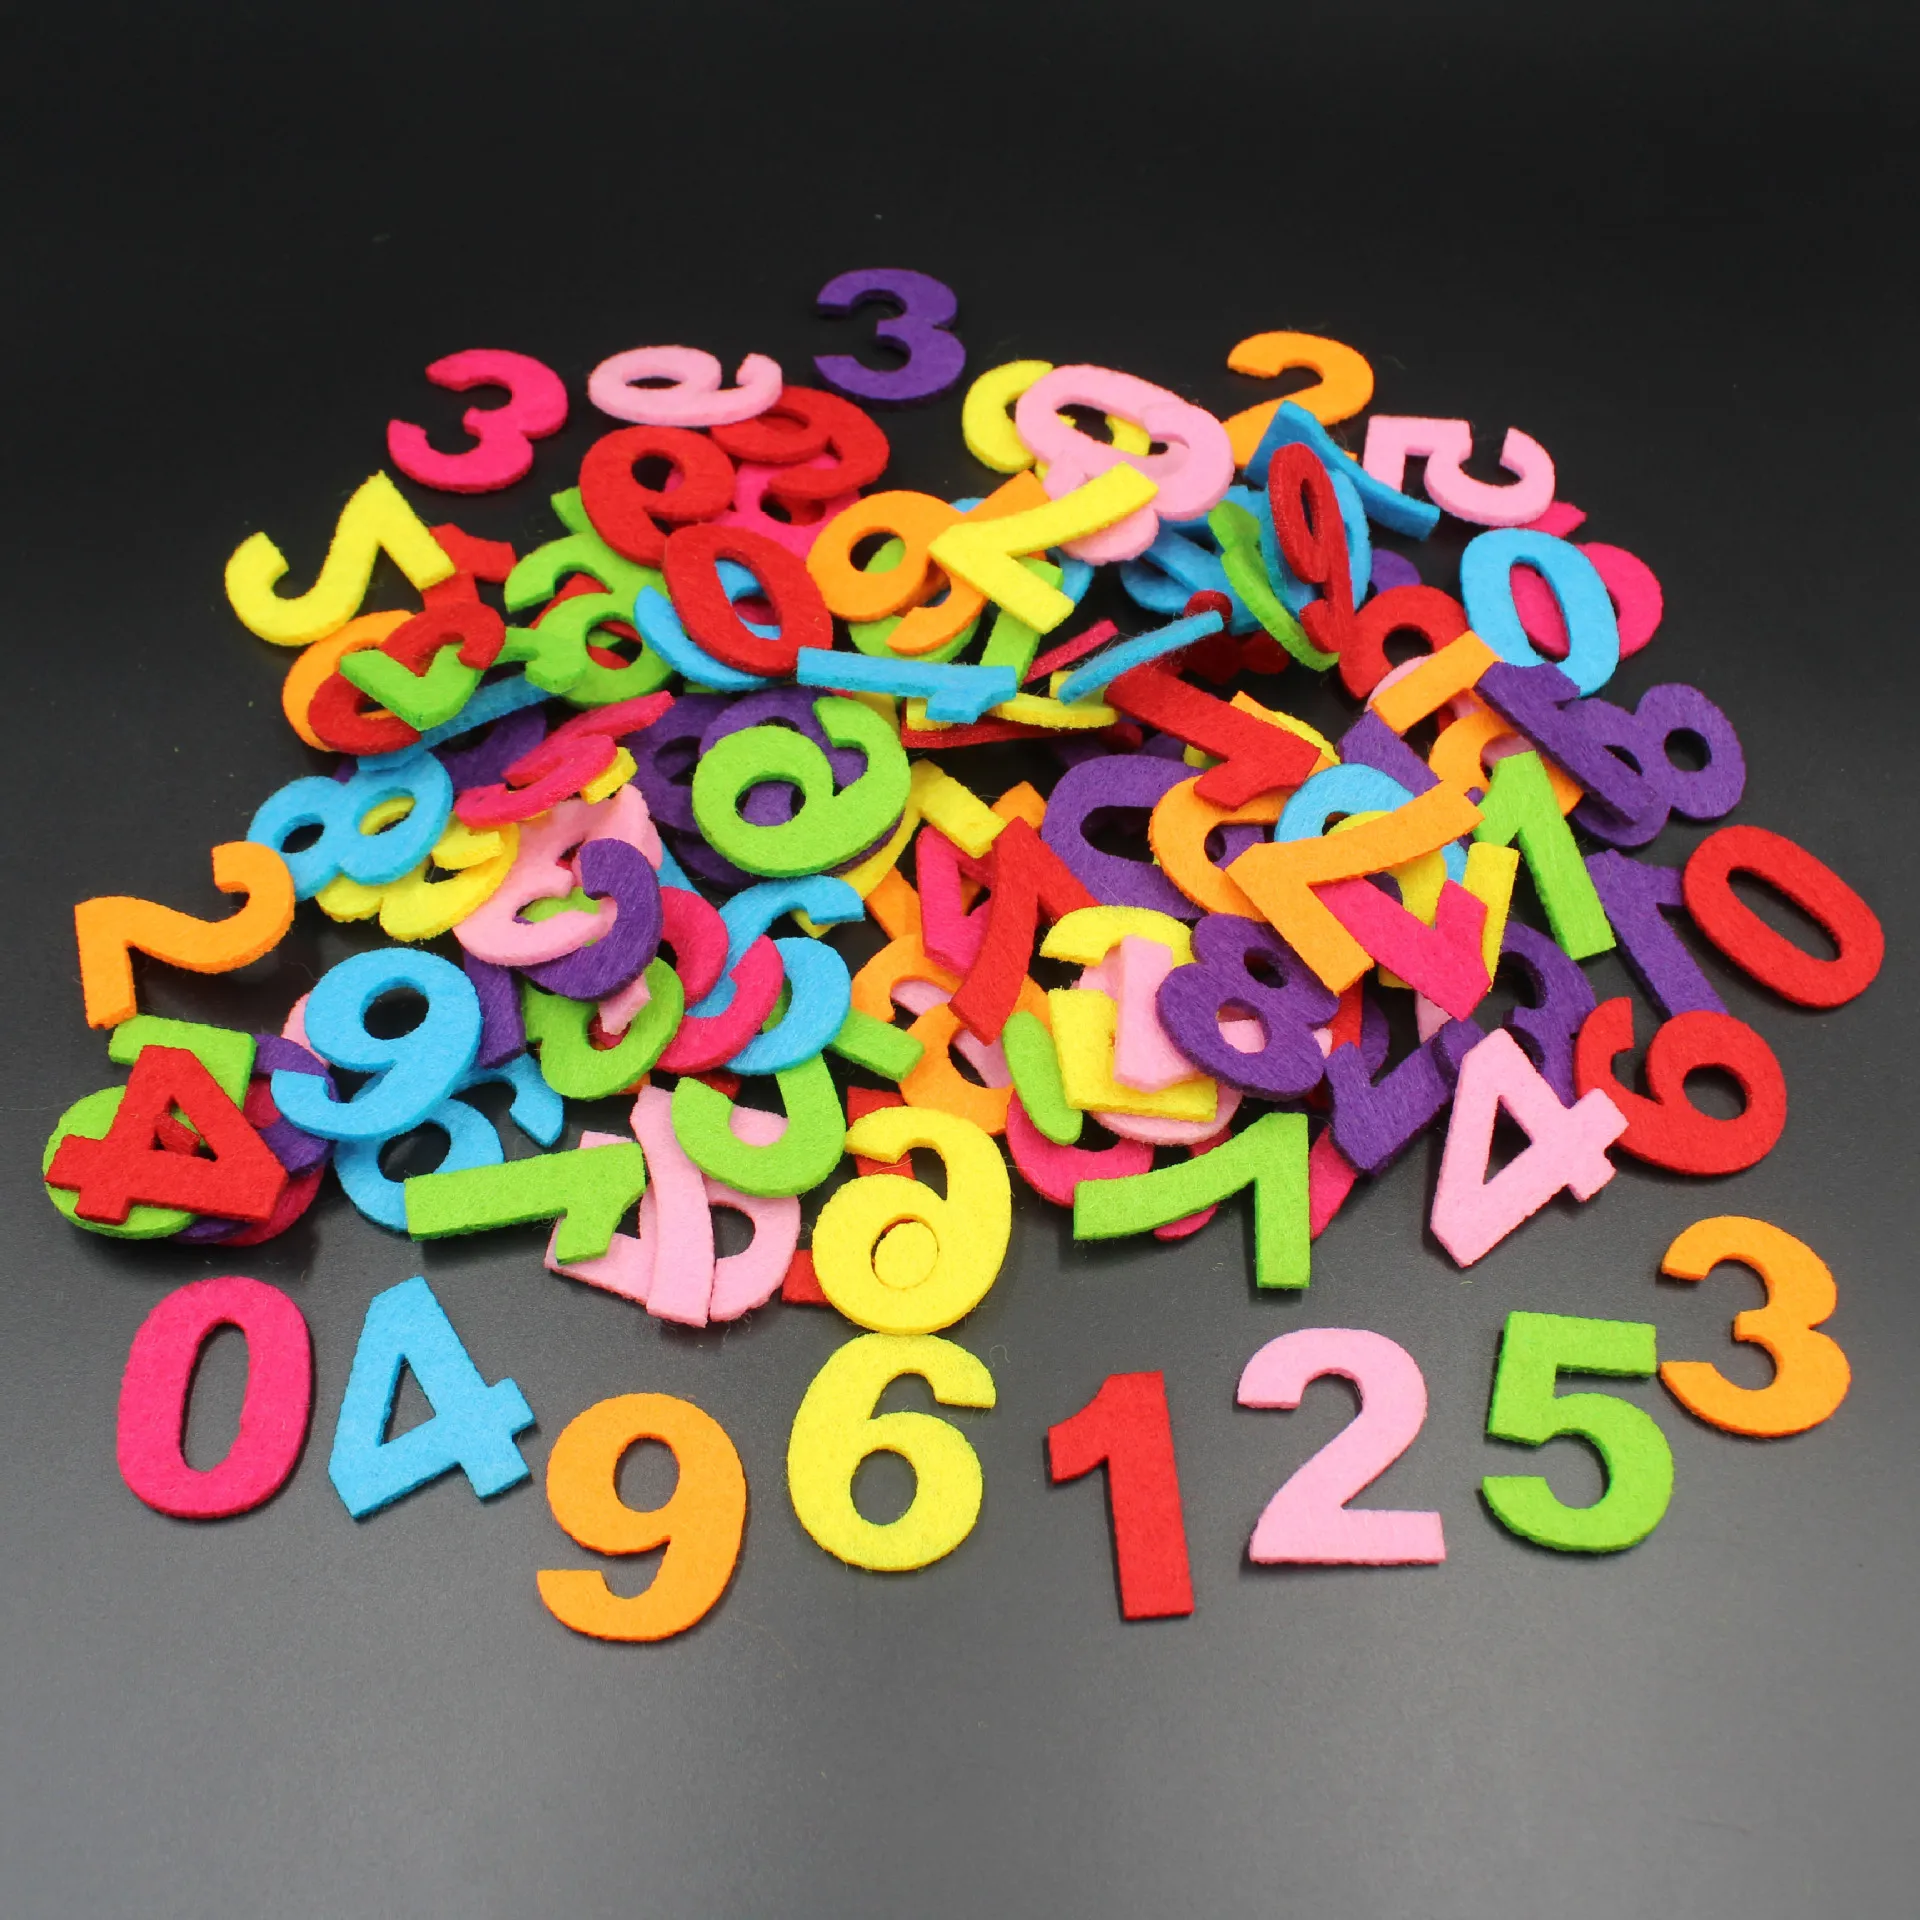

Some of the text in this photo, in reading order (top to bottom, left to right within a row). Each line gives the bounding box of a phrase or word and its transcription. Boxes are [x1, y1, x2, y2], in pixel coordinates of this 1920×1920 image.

[387, 349, 568, 493] 3
[815, 268, 966, 402] 3
[664, 522, 833, 677] 0
[928, 460, 1159, 634] 7
[1267, 441, 1356, 655] 9
[1459, 528, 1621, 698] 0
[246, 752, 454, 901] 8
[1225, 779, 1486, 996] 7
[1682, 825, 1885, 1010] 0
[74, 840, 295, 1029] 2
[1156, 913, 1341, 1100] 8
[44, 1044, 289, 1226] 4
[271, 947, 483, 1141] 9
[1430, 1028, 1630, 1268] 4
[116, 1276, 312, 1520] 0
[328, 1276, 537, 1522] 4
[1660, 1215, 1851, 1437] 3
[537, 1392, 747, 1643] 9
[786, 1333, 997, 1571] 6
[1047, 1370, 1194, 1621] 1
[1236, 1327, 1447, 1566] 2
[1482, 1310, 1674, 1554] 5
